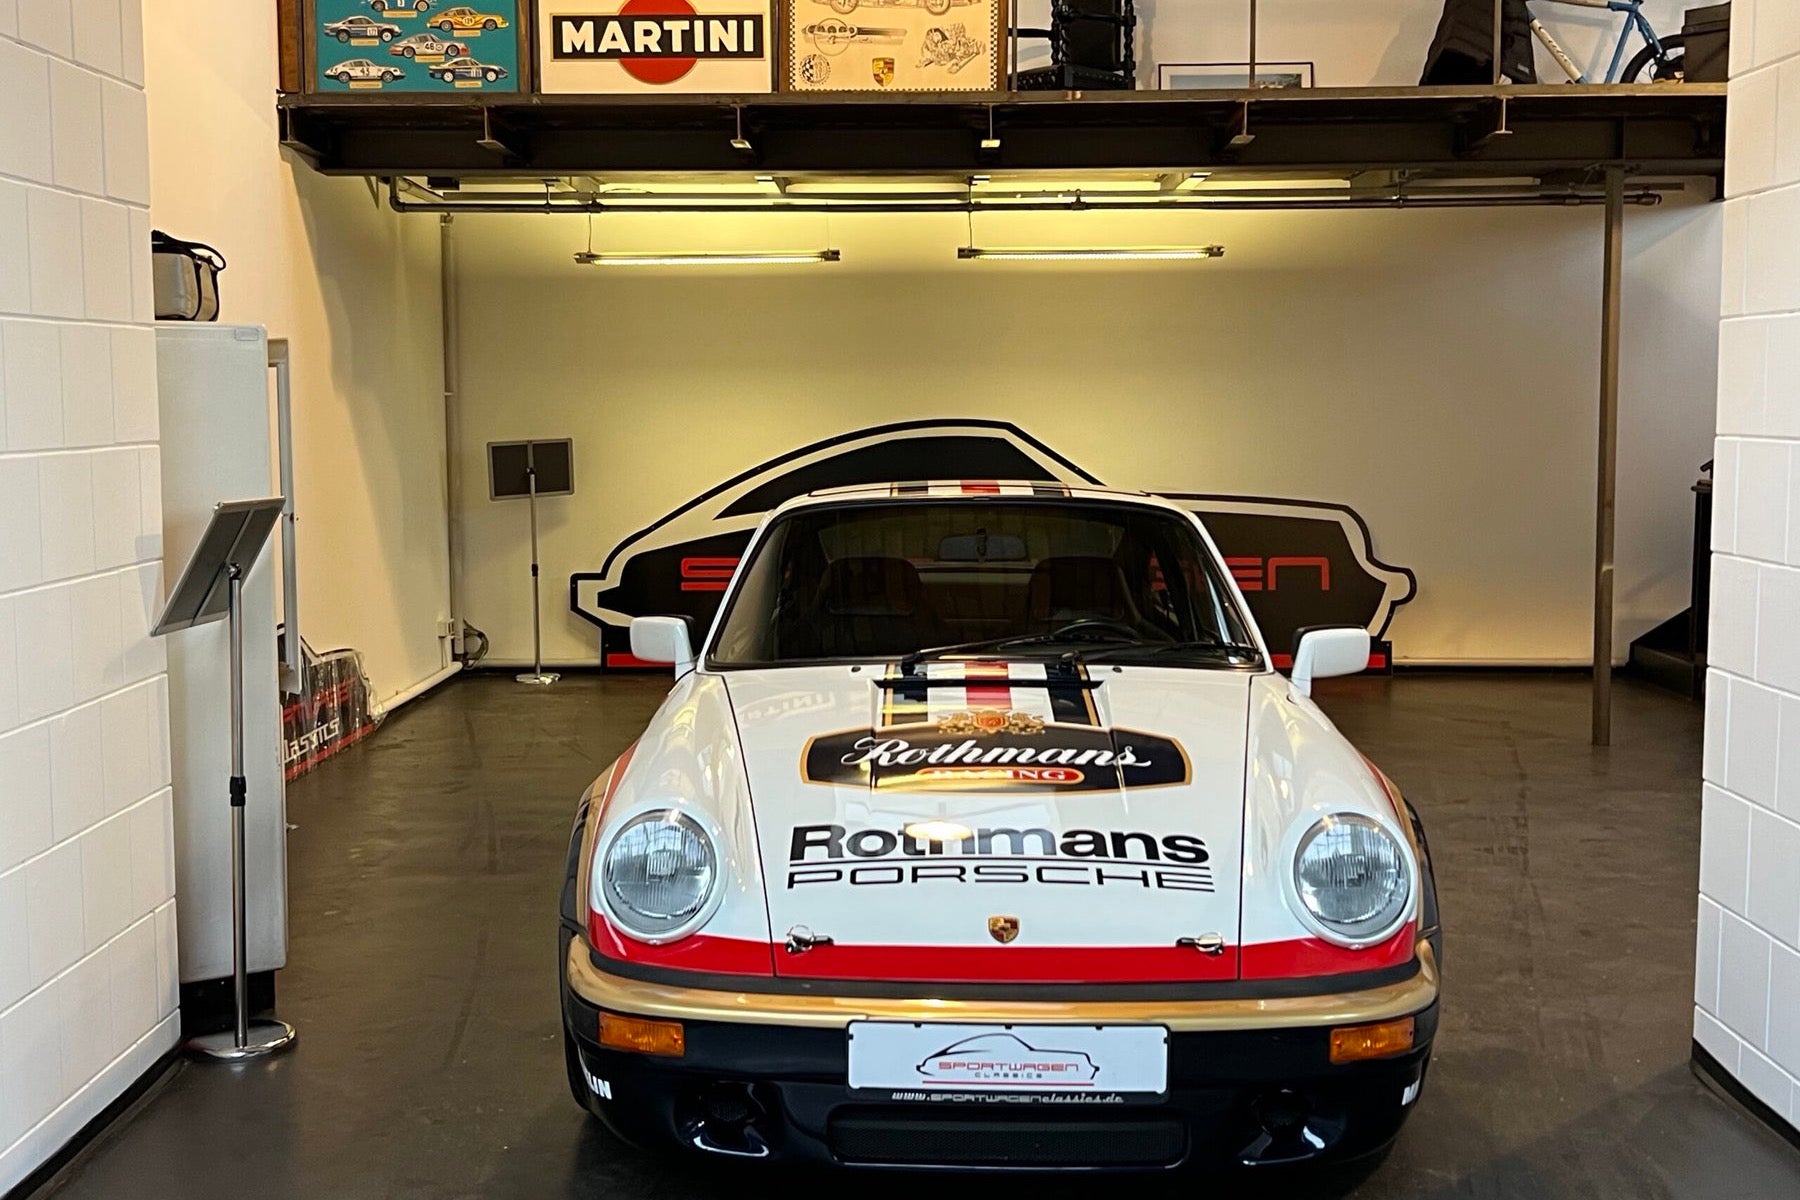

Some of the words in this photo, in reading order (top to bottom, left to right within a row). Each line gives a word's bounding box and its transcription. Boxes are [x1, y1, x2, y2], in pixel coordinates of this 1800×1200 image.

[561, 20, 755, 54] MARTINI
[841, 737, 1151, 768] Rothmans
[932, 769, 1066, 781] ING
[787, 864, 1215, 893] PORSCHE
[939, 1061, 1079, 1072] SPORTWAGEN
